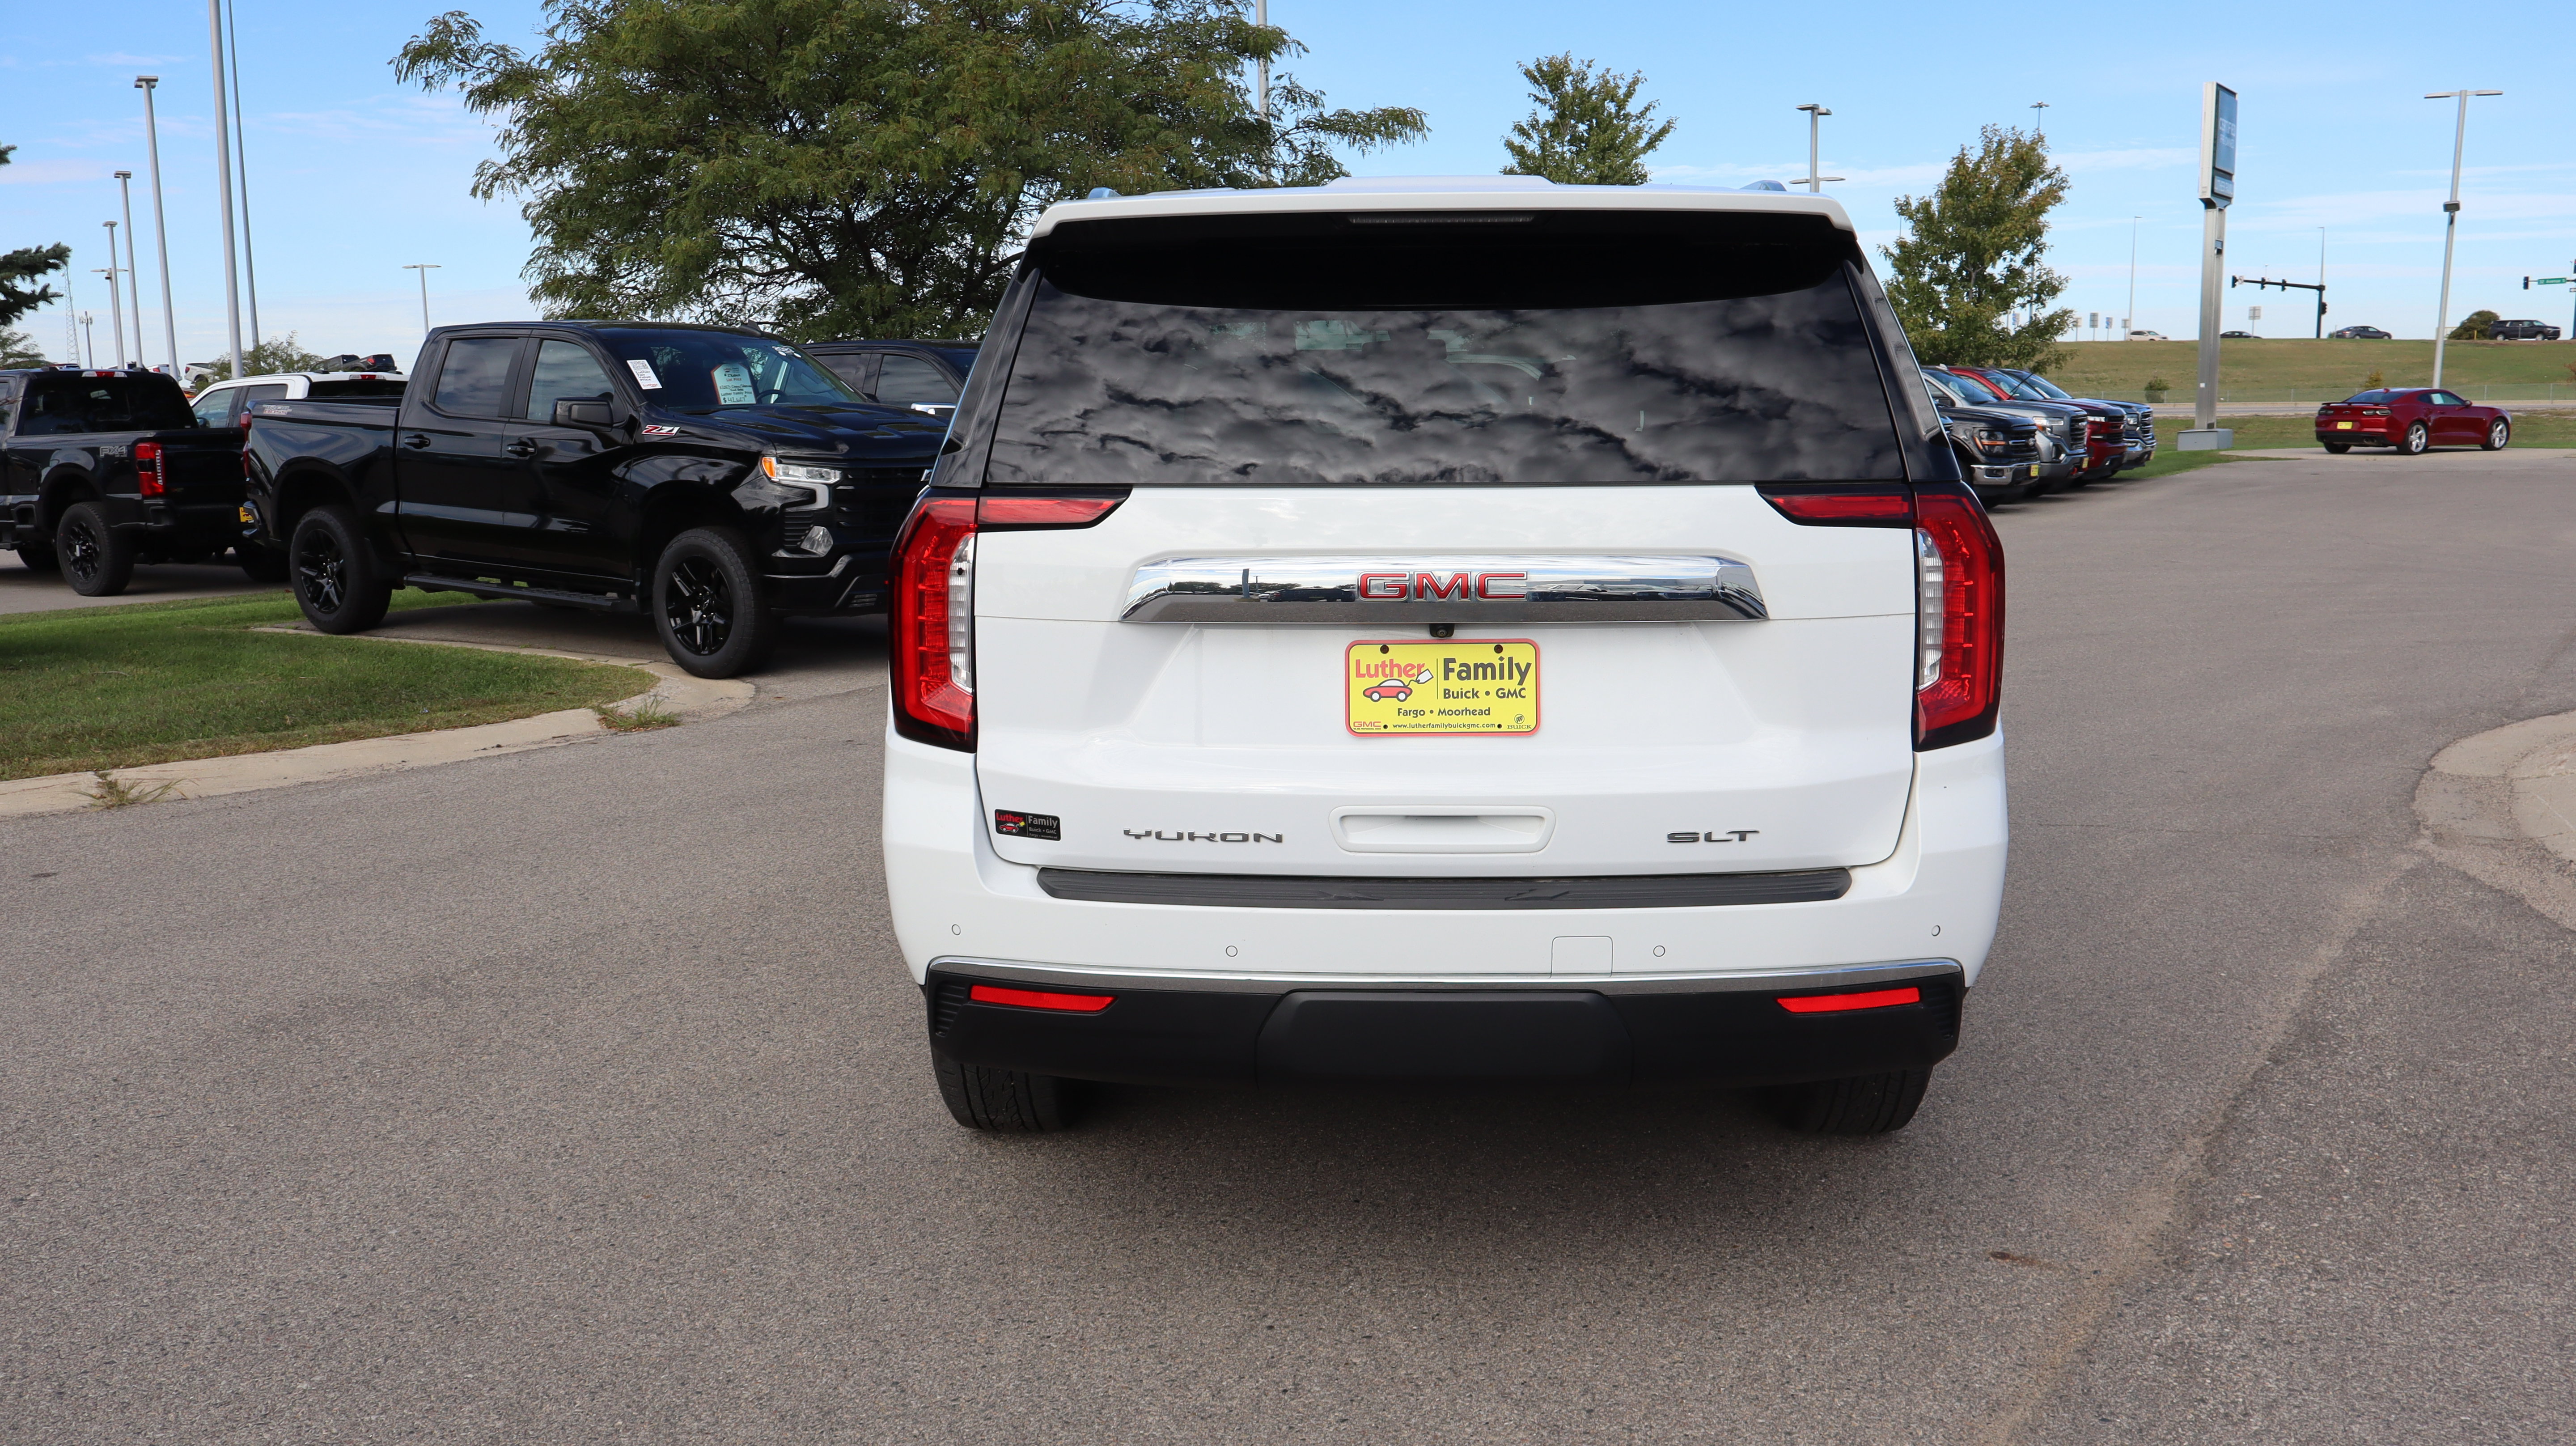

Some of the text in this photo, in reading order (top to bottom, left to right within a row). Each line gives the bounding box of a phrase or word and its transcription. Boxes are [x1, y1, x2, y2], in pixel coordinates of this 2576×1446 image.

[641, 424, 680, 436] Z71
[100, 446, 127, 458] FX4
[1358, 571, 1527, 602] GMC
[1356, 656, 1532, 686] Luther Family
[1443, 688, 1526, 699] Buick GMC
[1397, 707, 1491, 718] Fargo Moorhead
[996, 812, 1058, 828] Luther Family
[1123, 828, 1282, 843] YUKON
[1667, 830, 1760, 842] SLT
